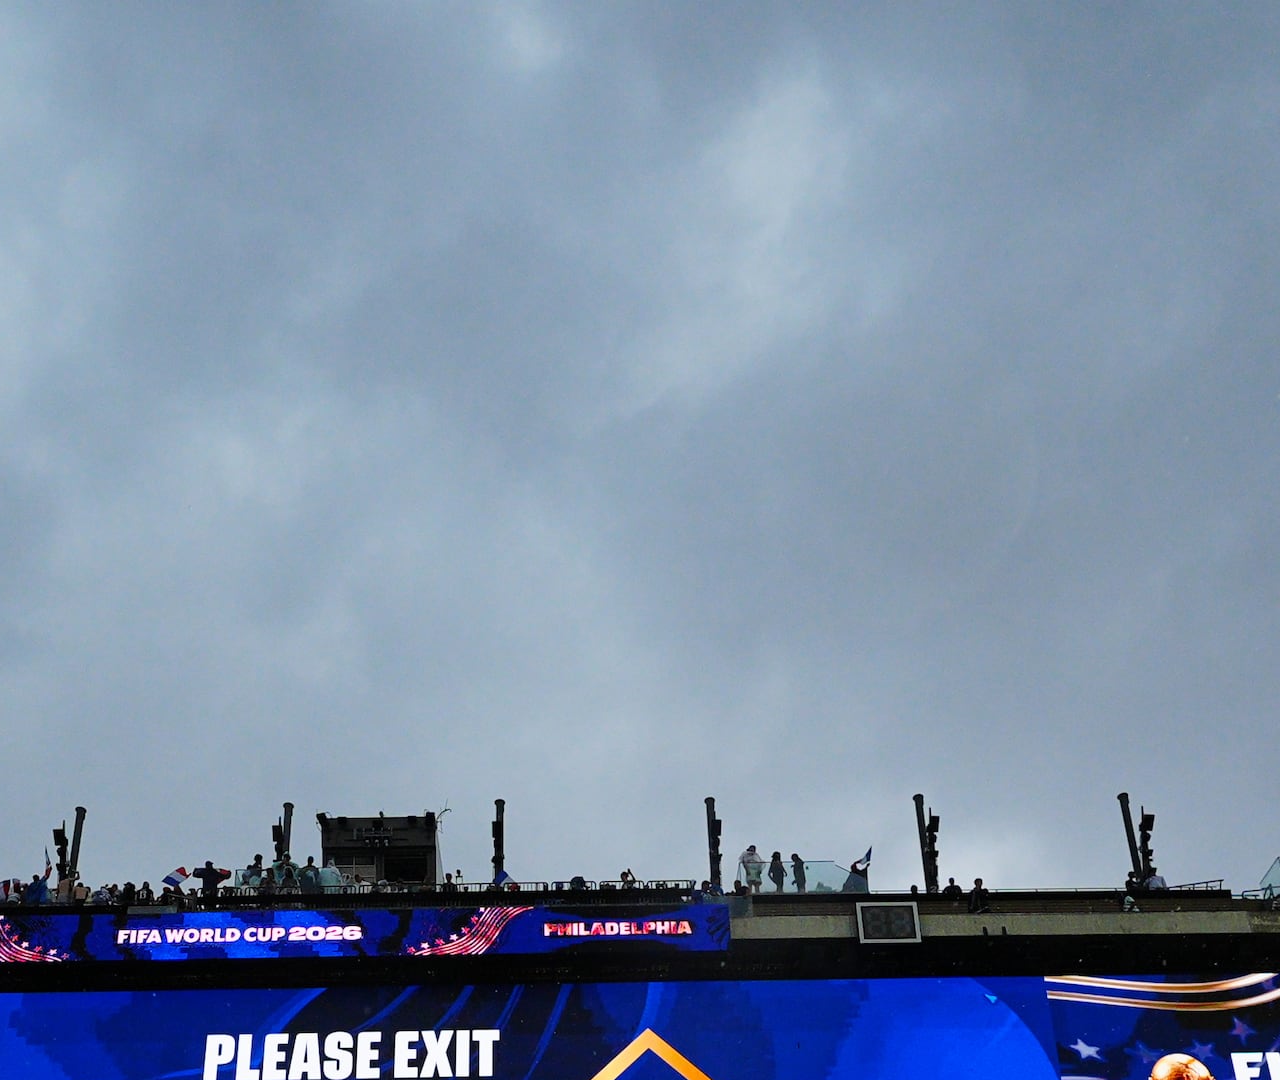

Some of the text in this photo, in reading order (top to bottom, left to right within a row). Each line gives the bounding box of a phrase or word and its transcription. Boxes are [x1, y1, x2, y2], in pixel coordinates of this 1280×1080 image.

[117, 925, 363, 945] FIFA WORLD CUP 2026
[544, 920, 692, 937] PHILADELPHIA
[393, 1029, 500, 1079] EXIT
